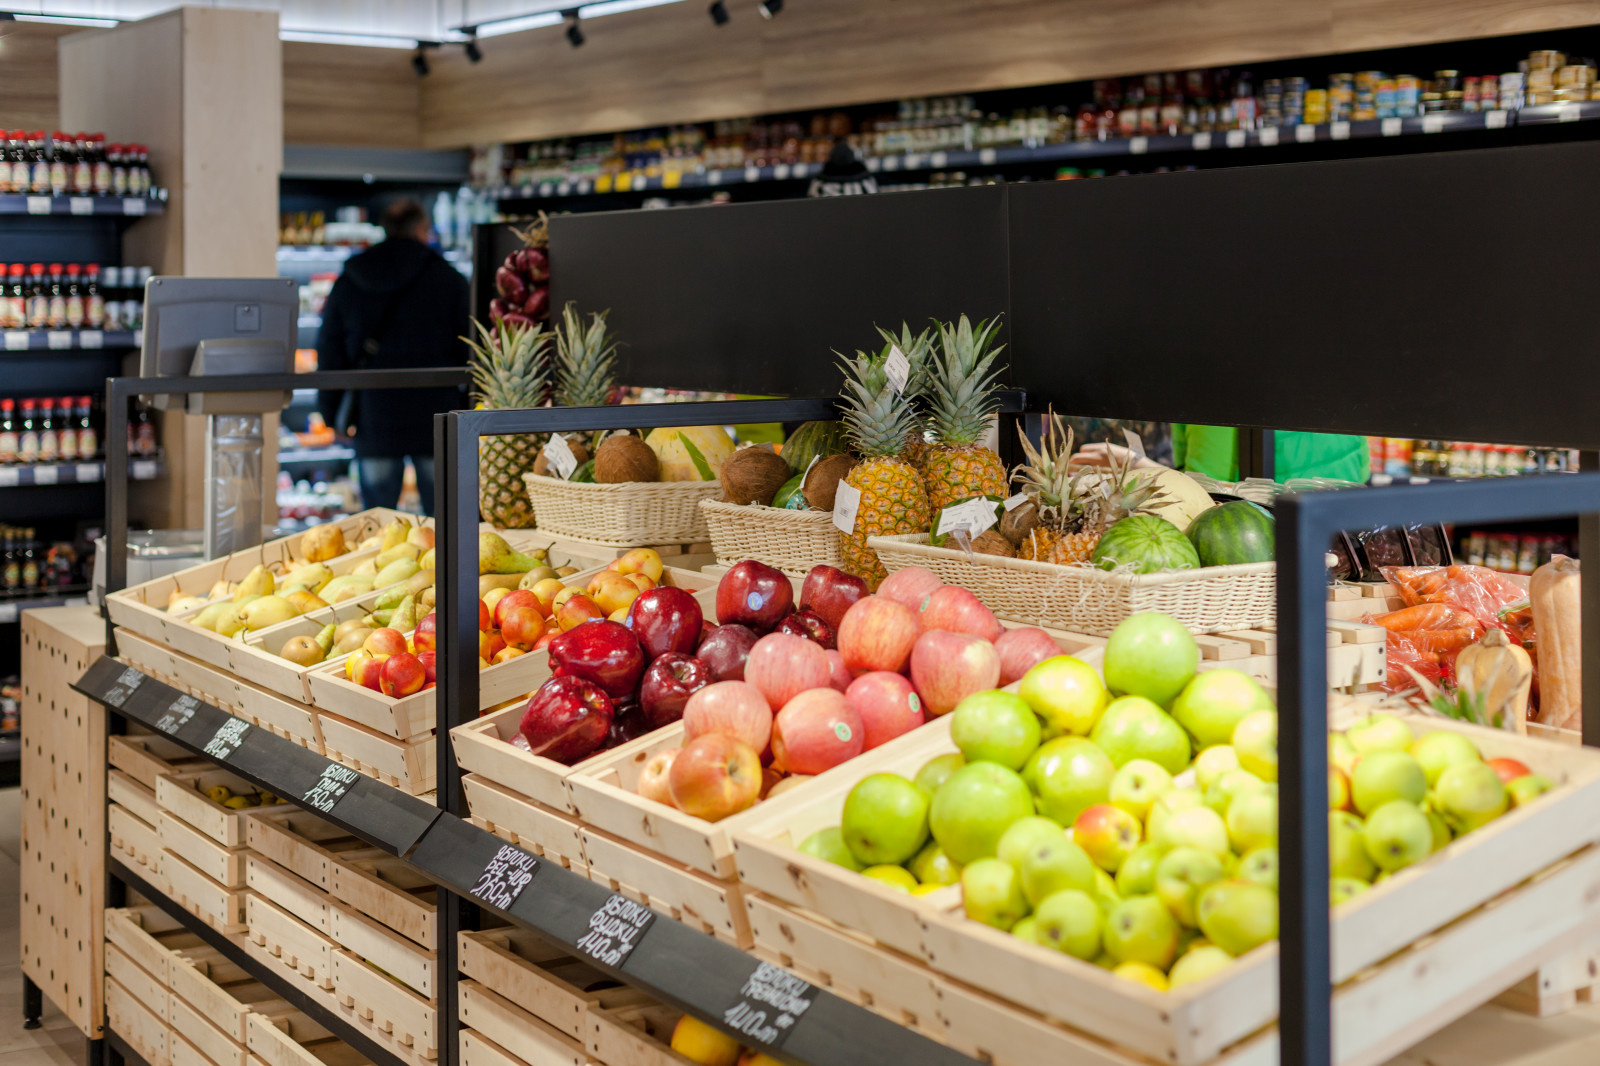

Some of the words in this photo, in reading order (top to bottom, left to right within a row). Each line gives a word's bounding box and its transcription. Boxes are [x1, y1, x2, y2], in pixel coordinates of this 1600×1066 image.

[320, 763, 358, 784] ЯБЛОКИ
[493, 845, 537, 872] ЯБЛОКИ
[589, 910, 640, 943] ФУДЖИ
[603, 895, 652, 928] ЯБЛОКИ
